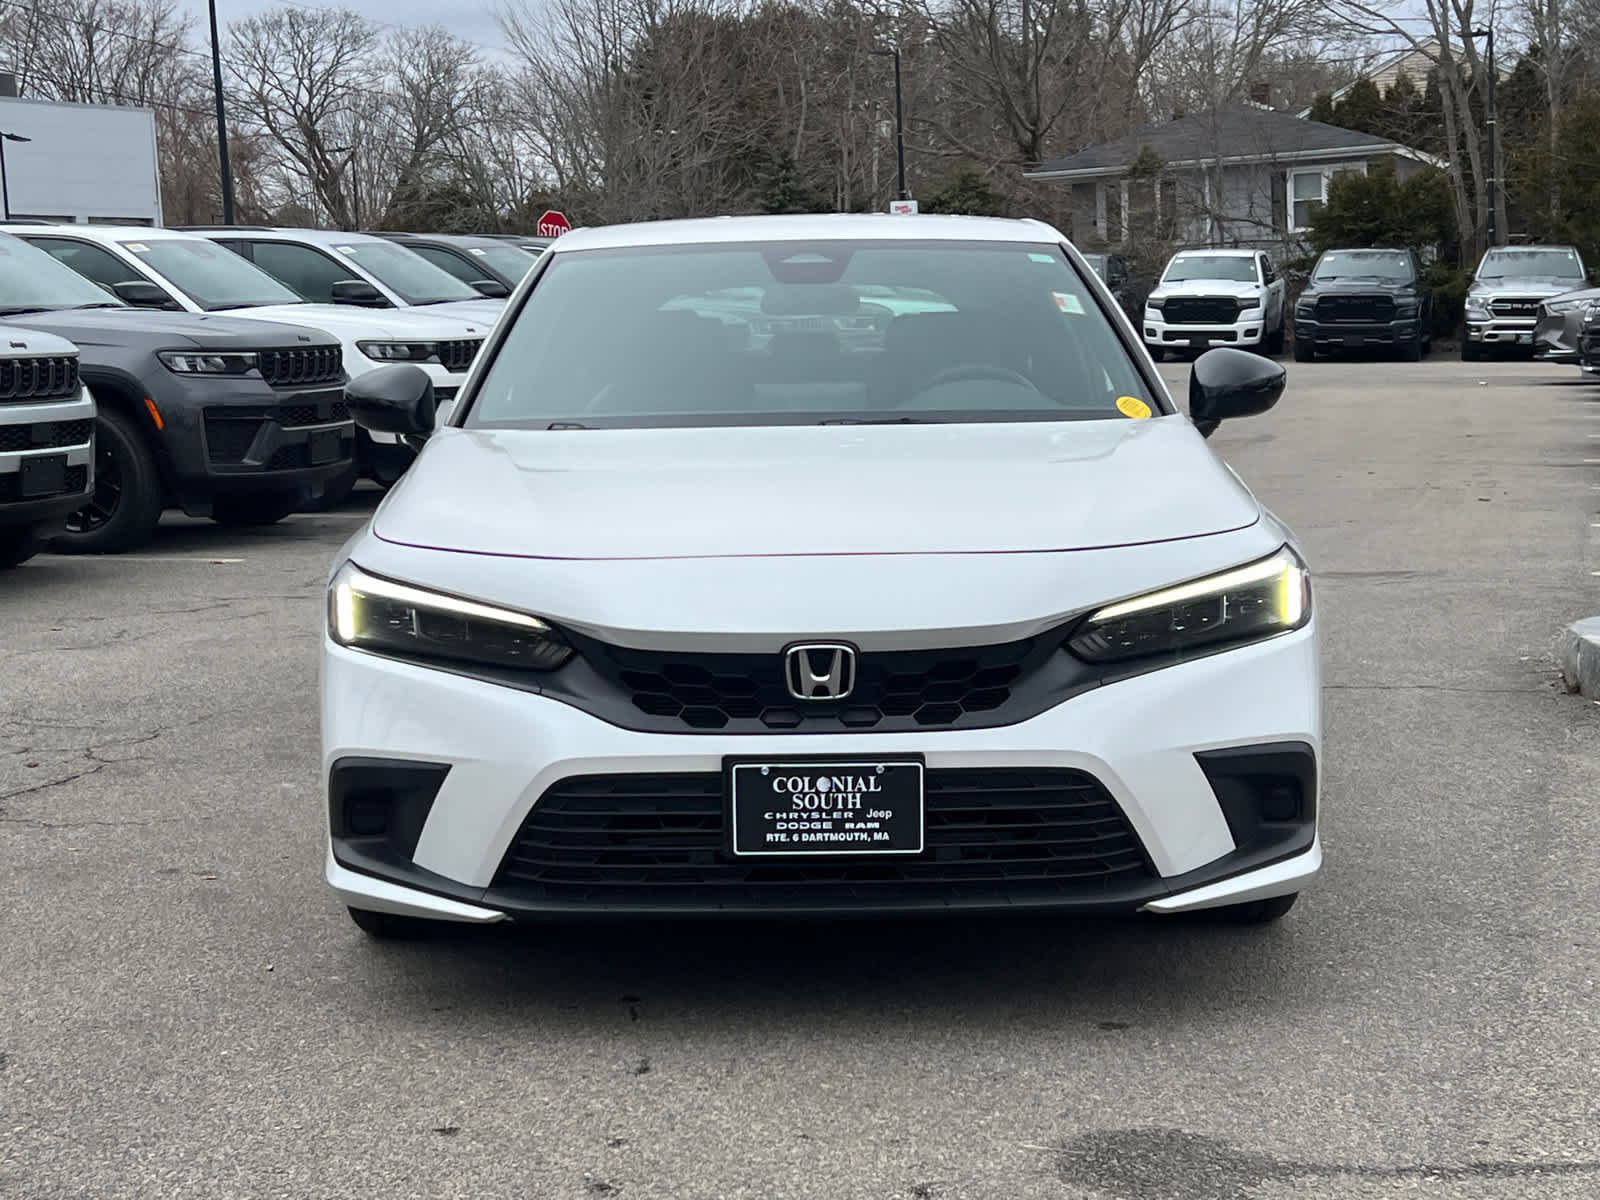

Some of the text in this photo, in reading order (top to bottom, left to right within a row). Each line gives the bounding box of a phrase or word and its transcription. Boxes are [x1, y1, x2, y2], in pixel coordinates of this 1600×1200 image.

[773, 776, 881, 793] COLONIAL
[792, 793, 862, 809] SOUTH
[764, 809, 892, 820] CHRYSLER Jeep
[766, 832, 890, 842] RTE. 6 DARTMOUTH, MA
